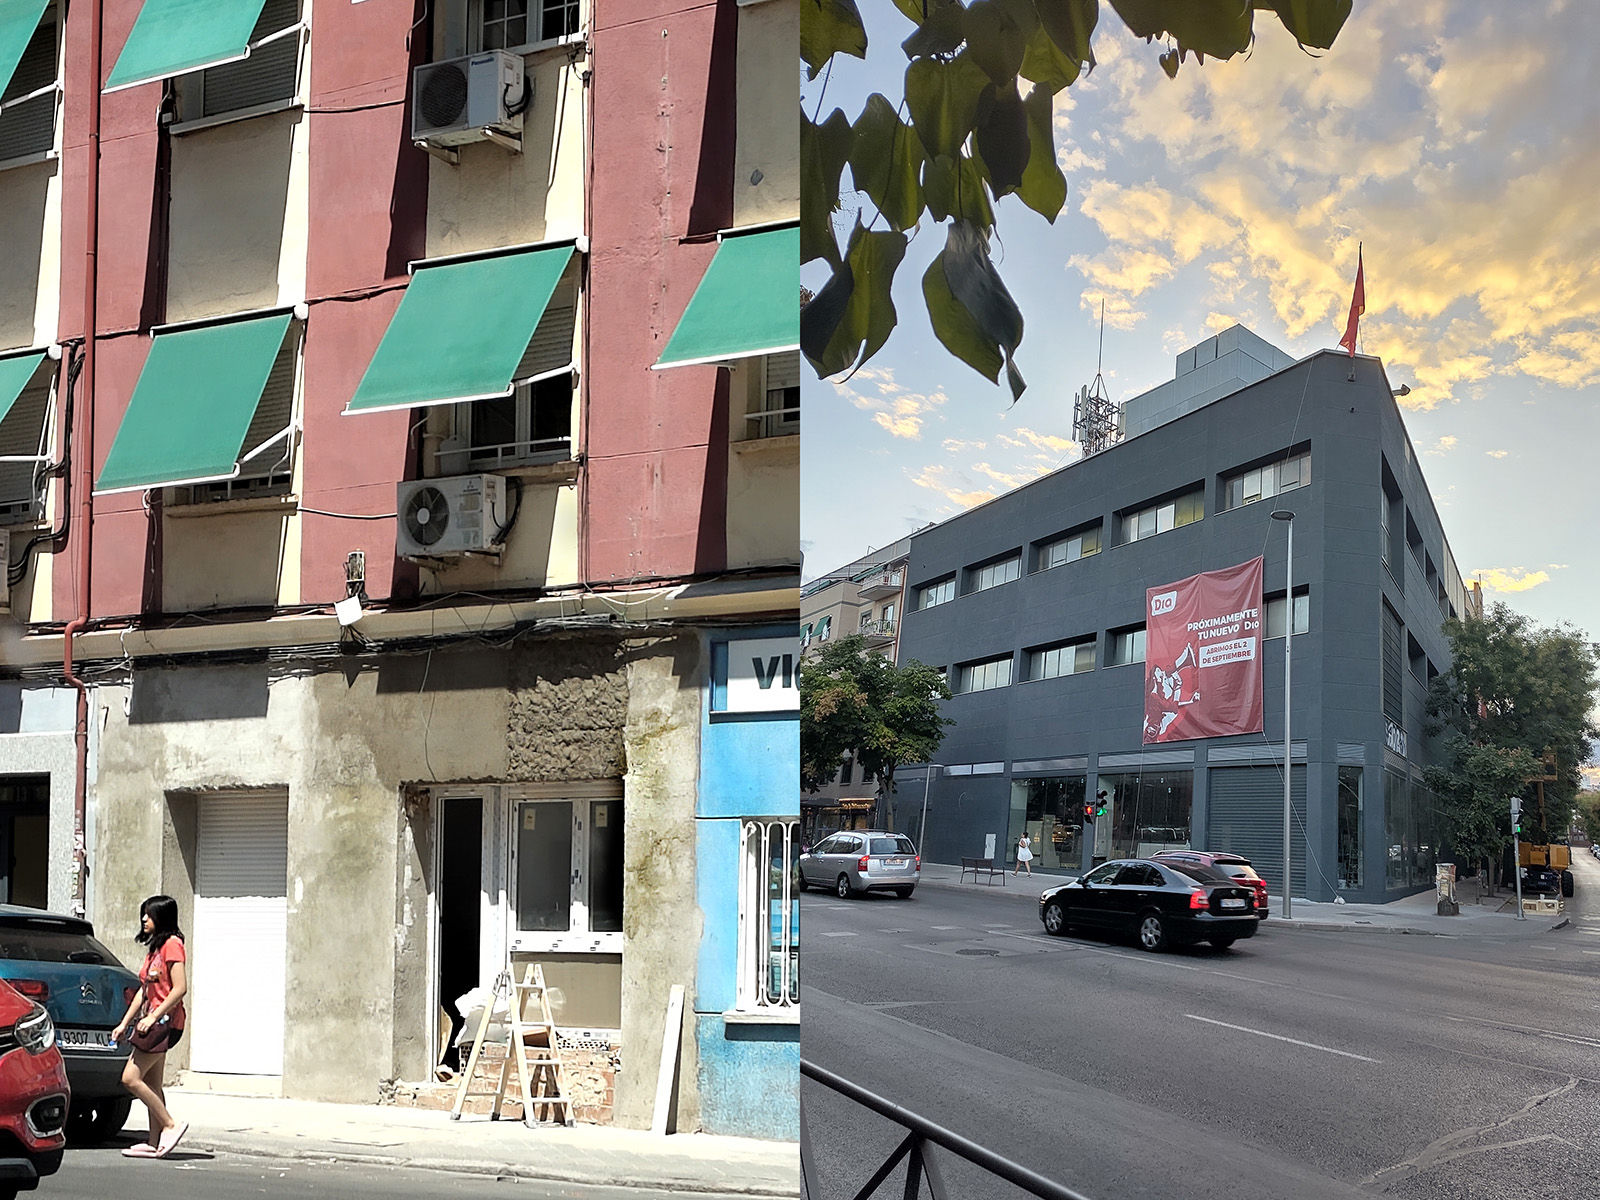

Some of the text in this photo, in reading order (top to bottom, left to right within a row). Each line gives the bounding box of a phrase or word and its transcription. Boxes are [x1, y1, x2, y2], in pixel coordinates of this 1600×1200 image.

[1187, 608, 1258, 632] PRÓXIMAMENTE
[1198, 631, 1209, 640] TU
[1210, 624, 1240, 638] NUEVO
[1206, 643, 1233, 655] ABRIMOS
[1212, 650, 1251, 663] SEPTIEMBRE
[752, 653, 800, 692] VI
[63, 1031, 88, 1046] 9307
